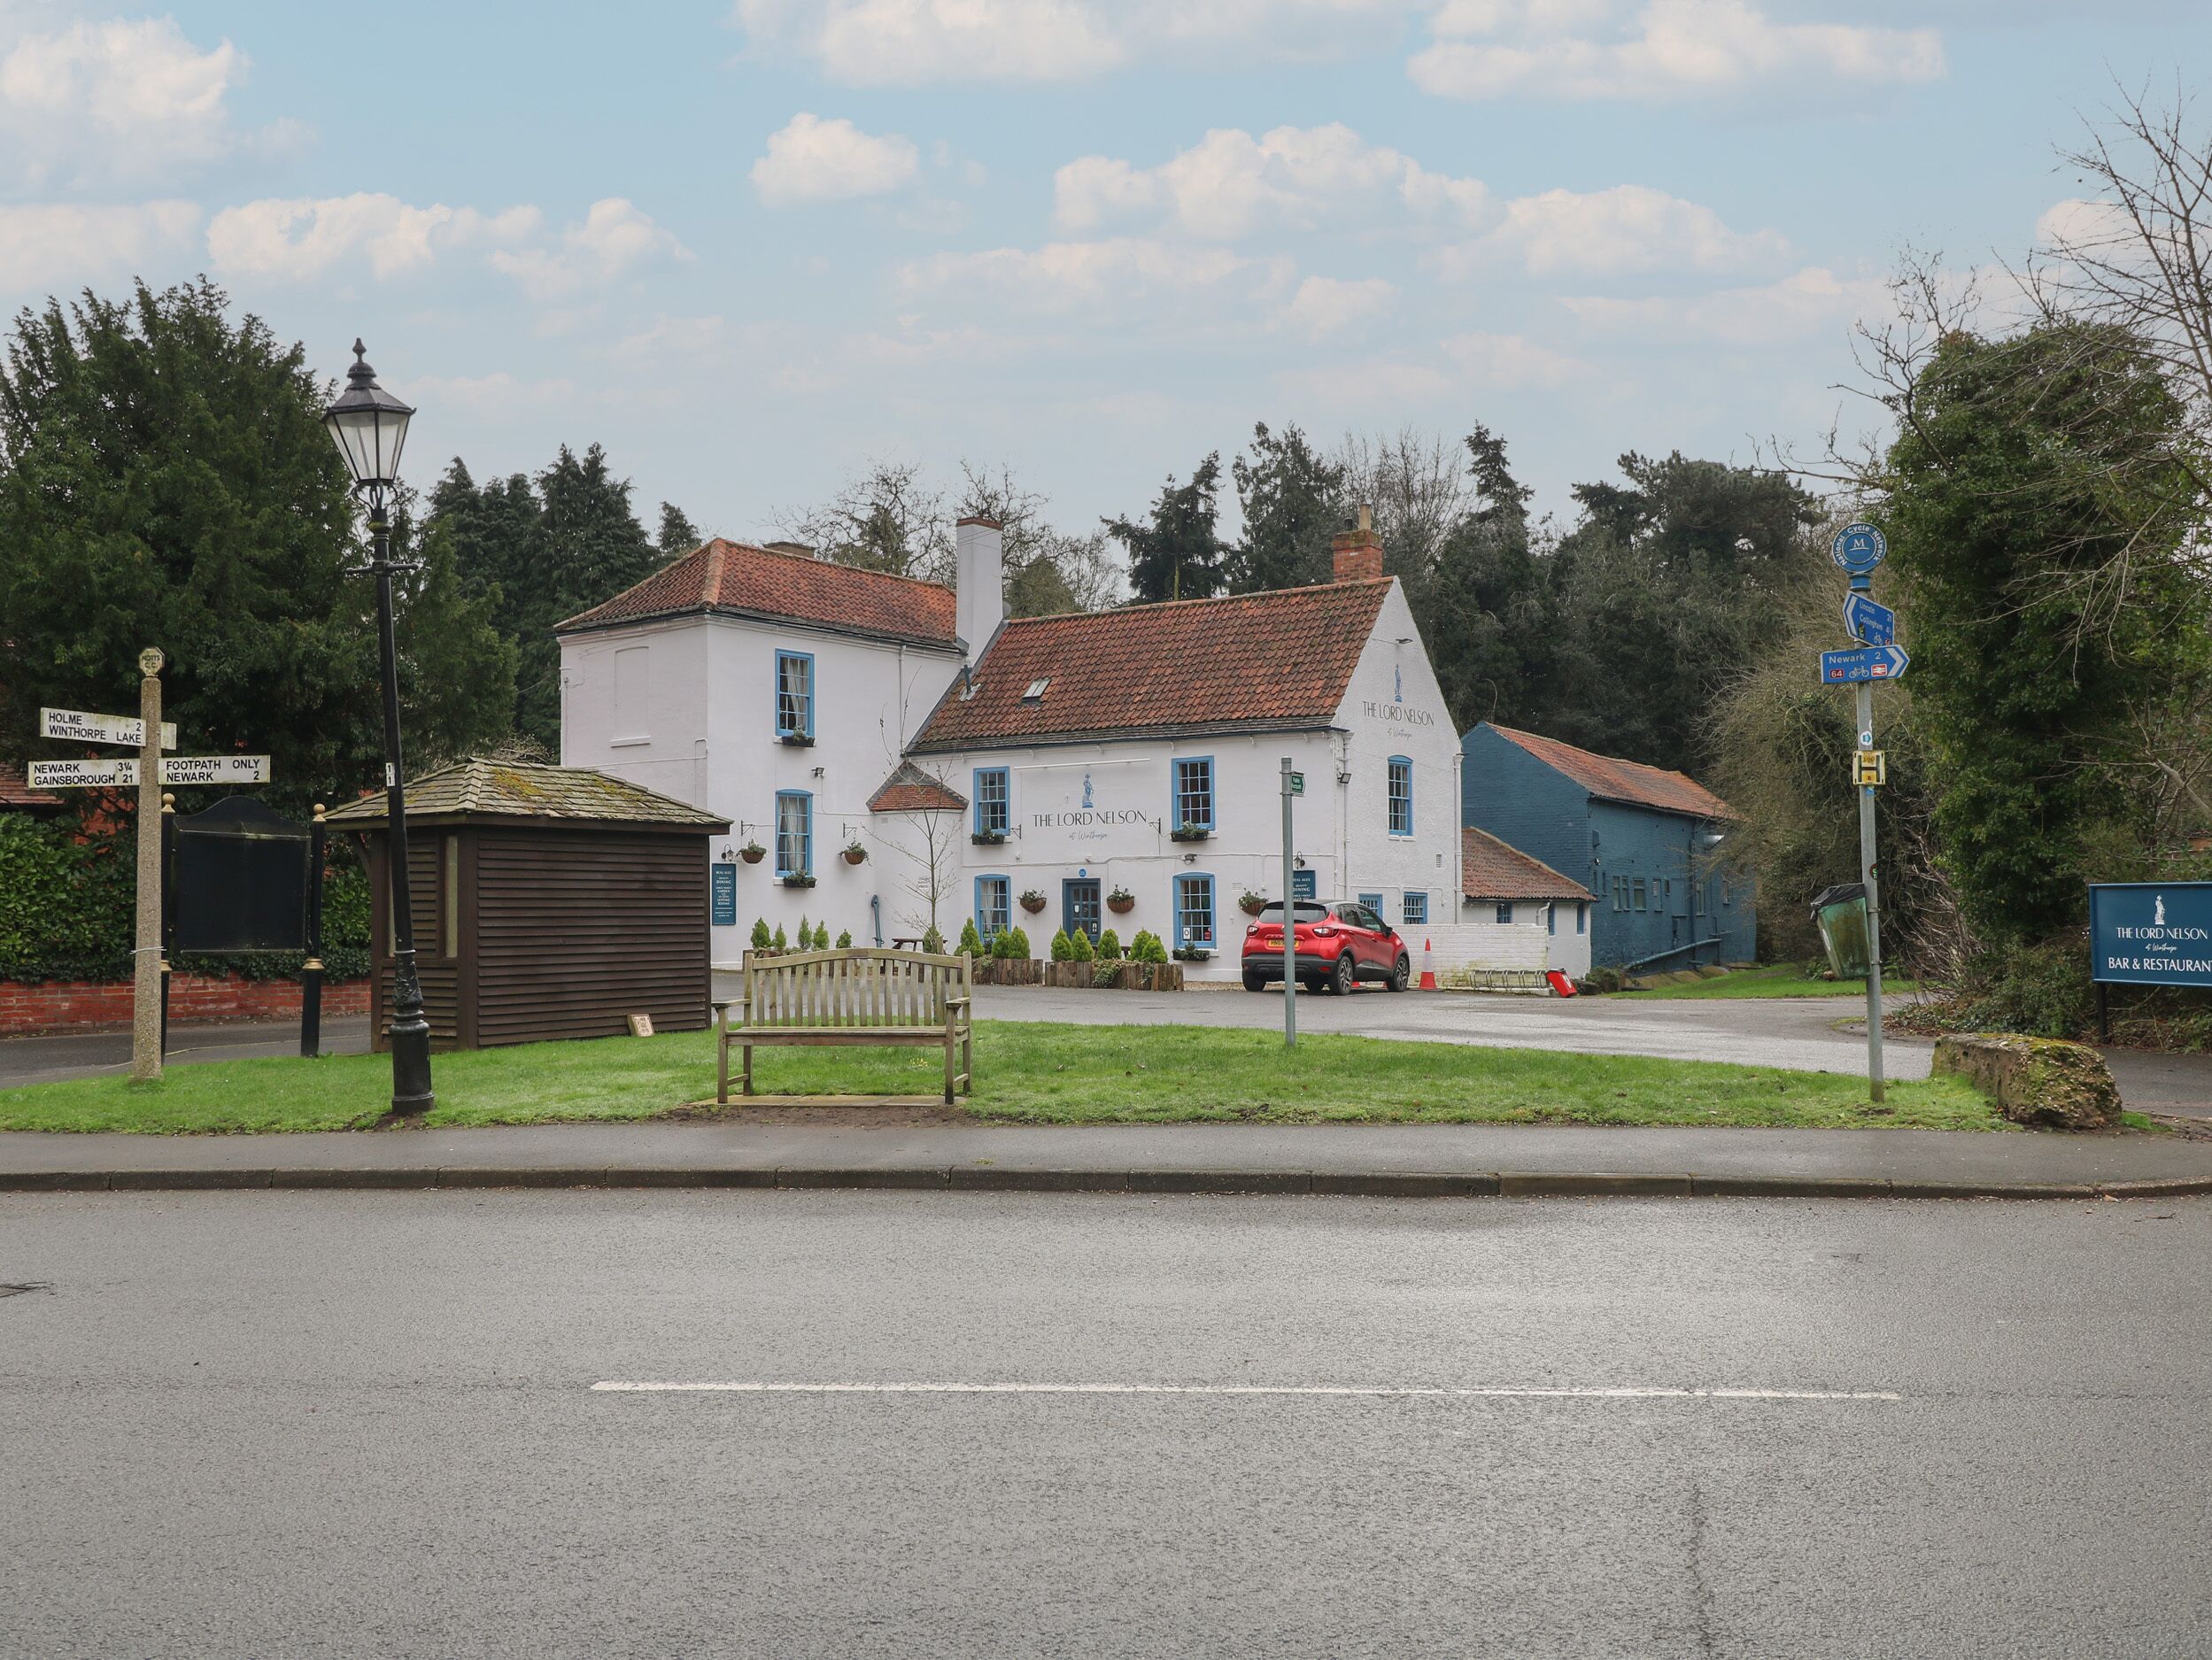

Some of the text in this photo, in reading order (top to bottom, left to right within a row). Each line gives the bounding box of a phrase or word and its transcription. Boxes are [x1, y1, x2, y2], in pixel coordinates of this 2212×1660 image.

[1847, 524, 1870, 534] Cycle
[1852, 537, 1865, 548] M
[1872, 530, 1883, 561] Network
[1834, 535, 1847, 566] National
[1829, 653, 1866, 664] Newark
[49, 712, 82, 725] HOLME
[1363, 700, 1434, 727] THE LORD NELSON
[136, 722, 142, 732] 2
[49, 725, 142, 744] WINTHORPE LAKE
[34, 763, 80, 774] NEWARK
[166, 759, 260, 770] FOOTPATH ONLY
[34, 774, 133, 785] GAINSBOROUGH 21
[166, 771, 259, 782] NEWARK 2
[1033, 809, 1147, 827] THE LORD NELSON
[2116, 927, 2208, 940] THE LORD NELSON
[2108, 957, 2131, 969] BAR
[2132, 958, 2140, 970] &
